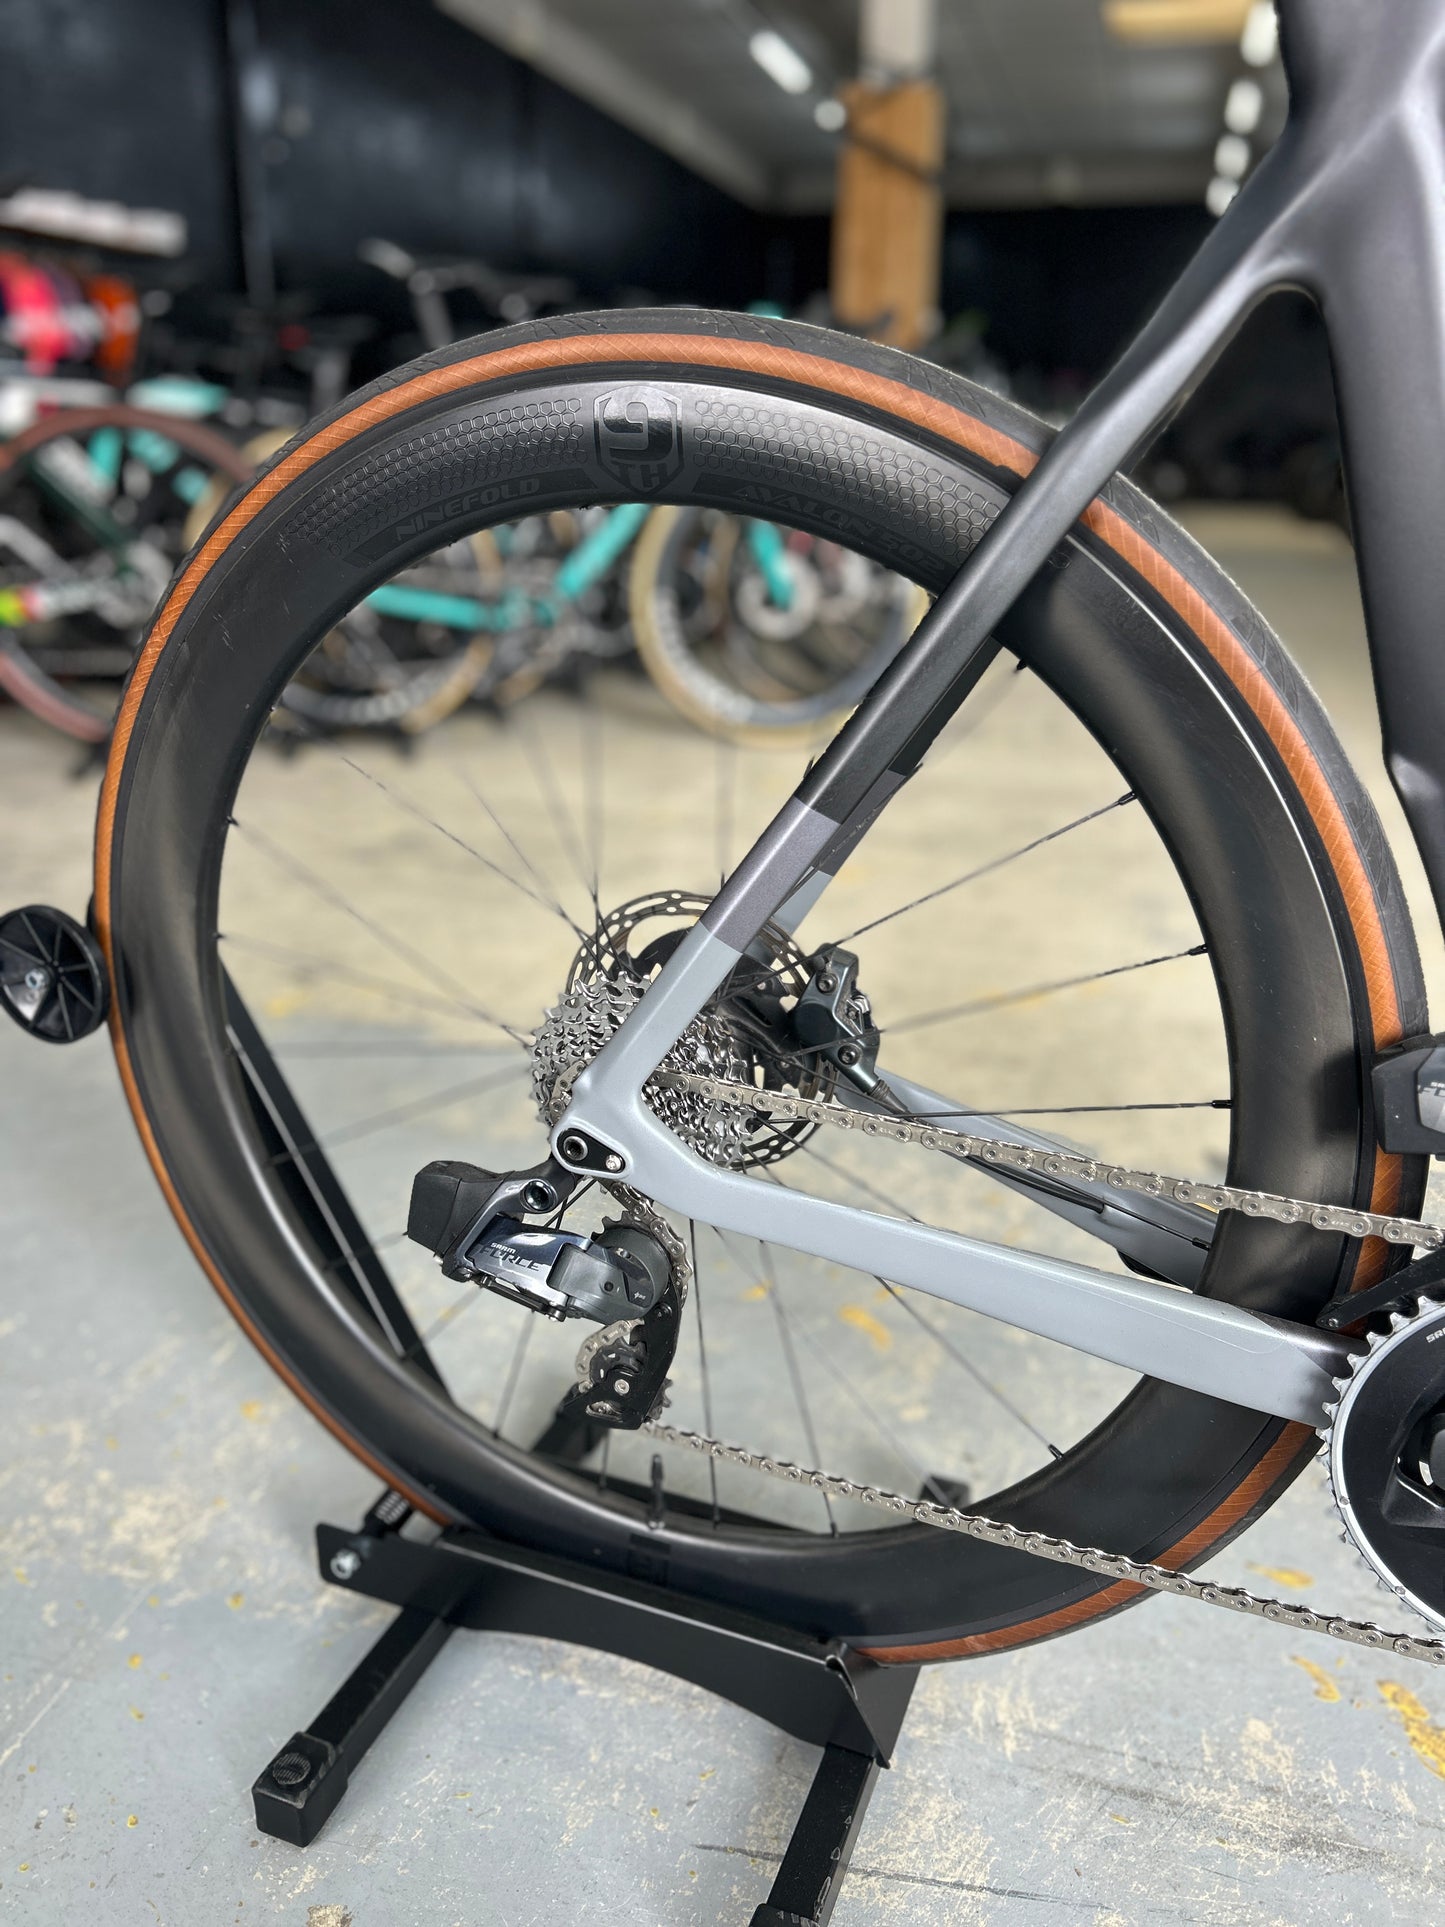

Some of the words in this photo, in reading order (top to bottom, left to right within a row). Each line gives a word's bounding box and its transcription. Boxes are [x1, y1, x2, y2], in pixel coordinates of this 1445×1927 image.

[603, 385, 673, 460] 9
[395, 477, 540, 541] NINEFOLD
[734, 484, 880, 540] AVALON
[480, 1246, 540, 1272] FORCE
[490, 1242, 516, 1254] SRAM
